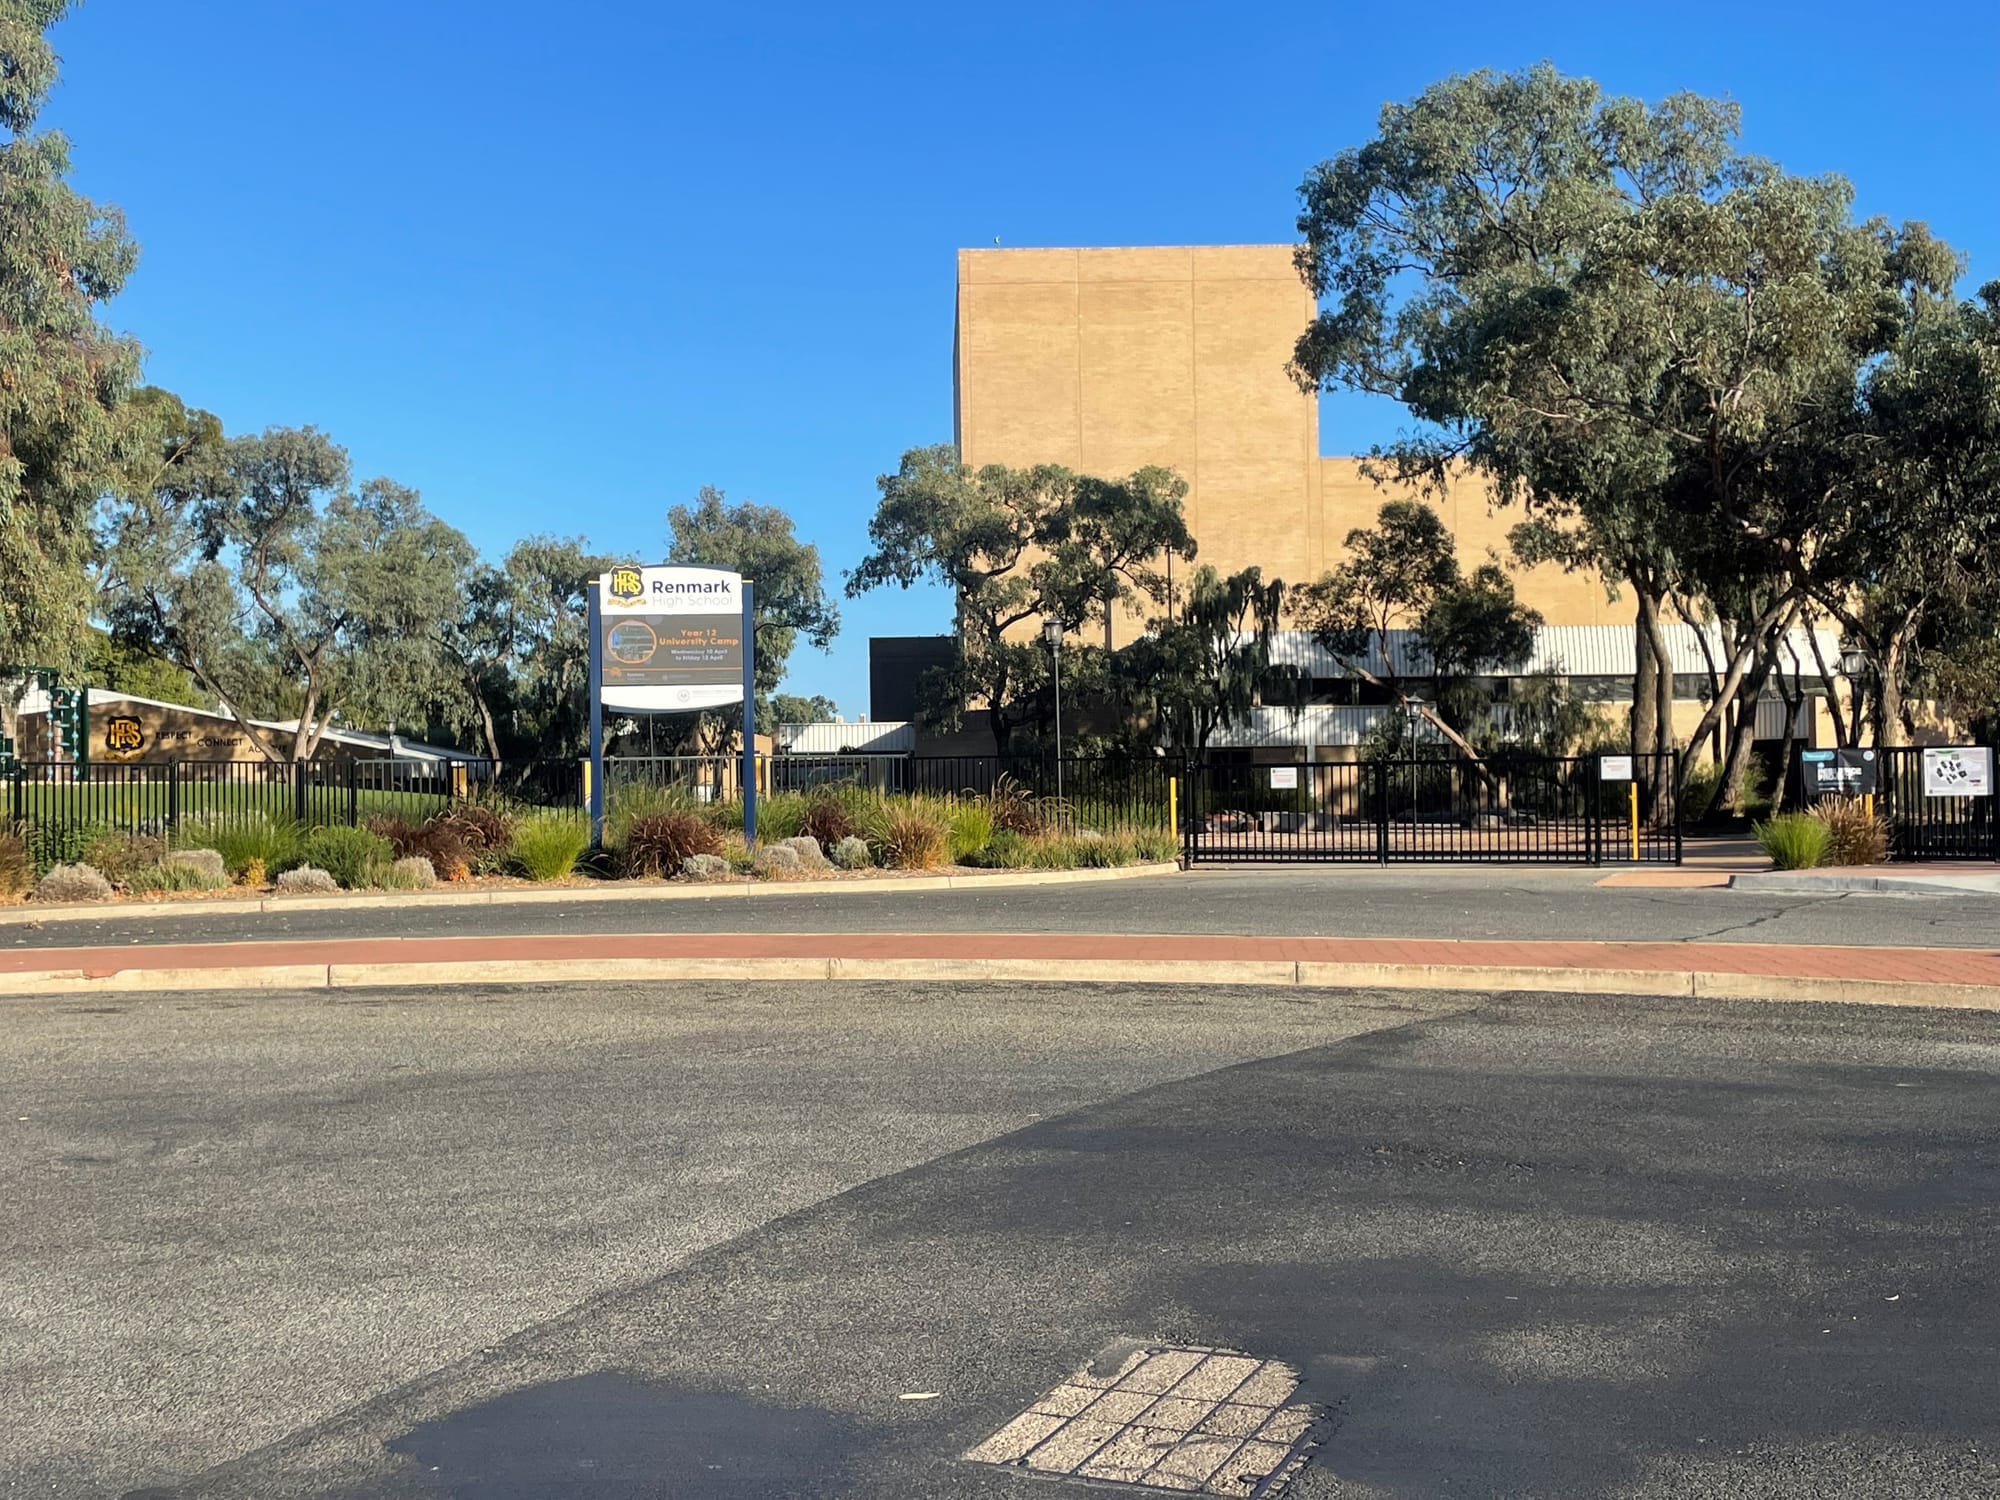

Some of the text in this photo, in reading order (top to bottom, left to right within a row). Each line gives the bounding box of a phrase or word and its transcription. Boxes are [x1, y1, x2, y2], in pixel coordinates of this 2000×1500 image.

[652, 580, 731, 593] Renmark
[652, 595, 683, 608] High
[688, 595, 733, 606] School
[681, 629, 703, 637] Year
[659, 637, 739, 646] University Camp
[155, 731, 193, 740] RESPECT
[197, 738, 243, 747] CONNECT
